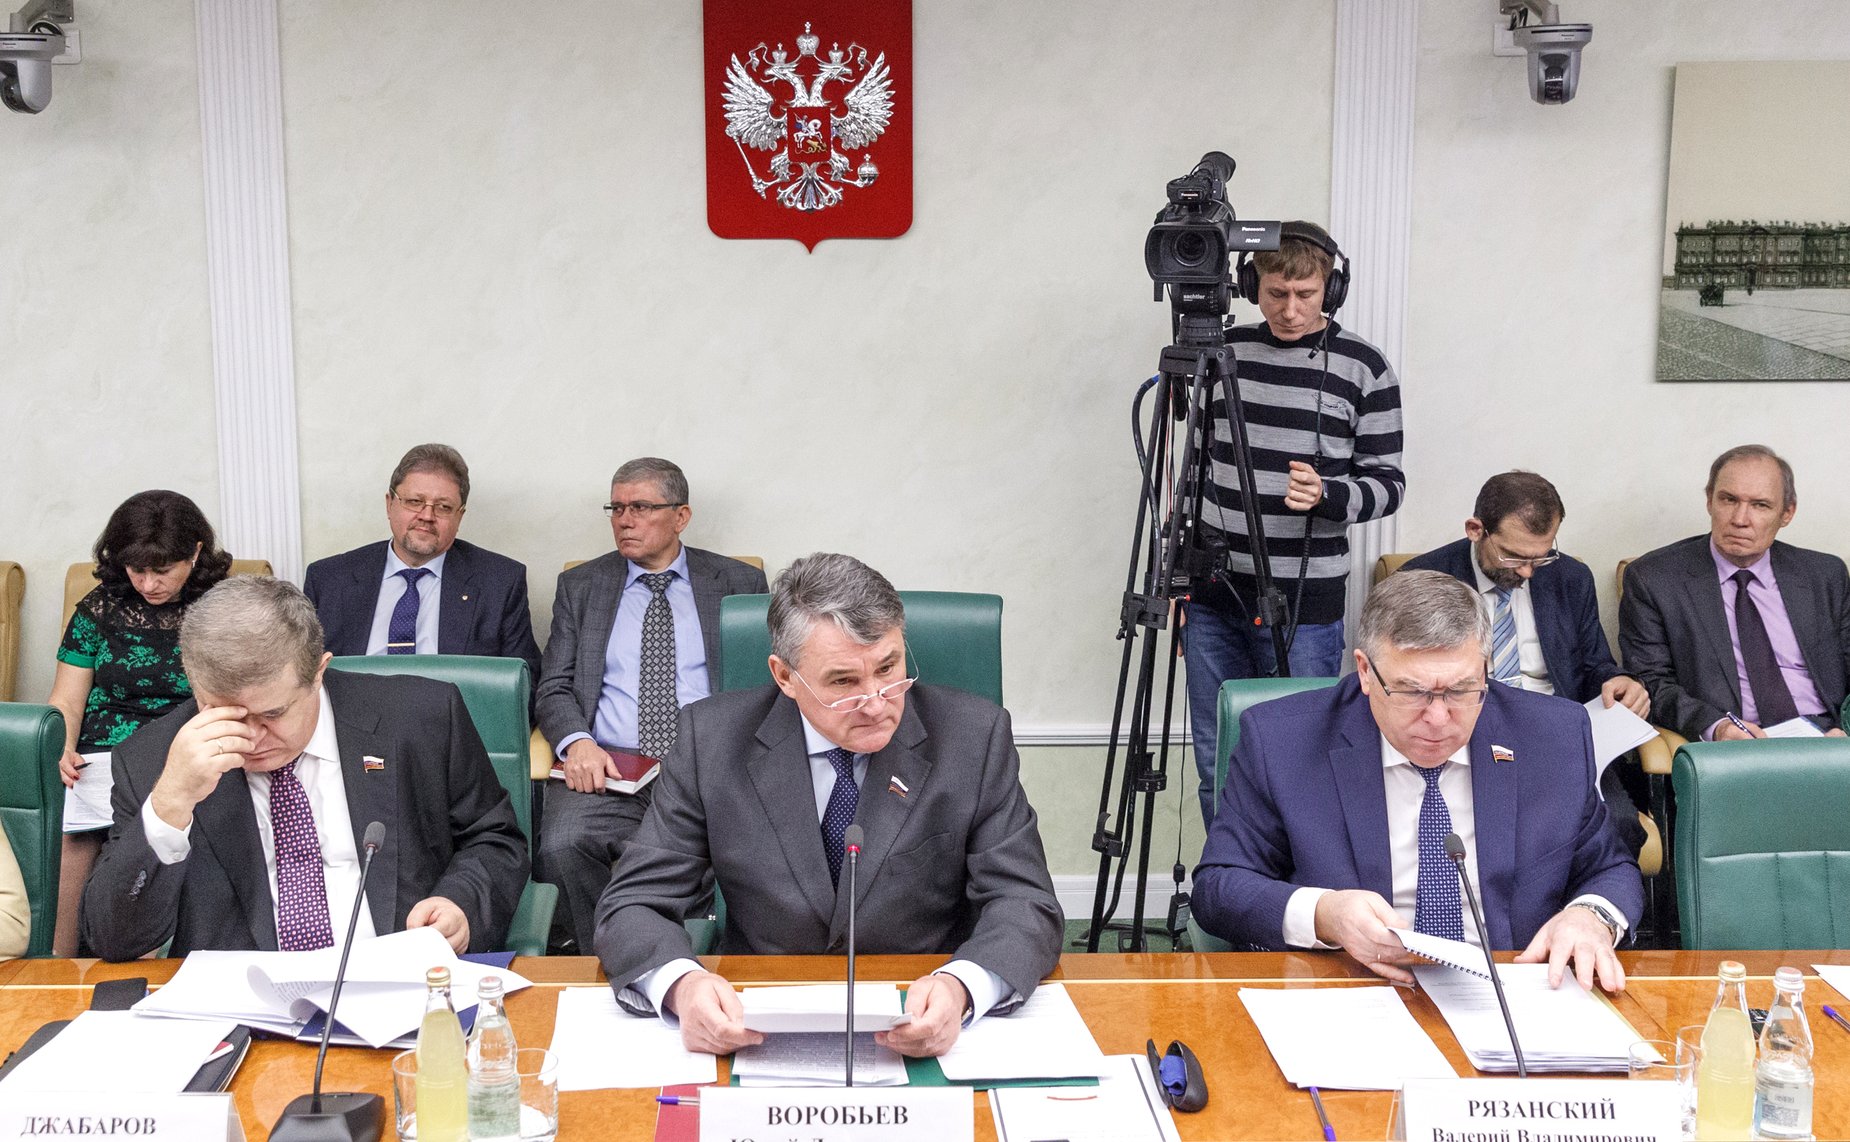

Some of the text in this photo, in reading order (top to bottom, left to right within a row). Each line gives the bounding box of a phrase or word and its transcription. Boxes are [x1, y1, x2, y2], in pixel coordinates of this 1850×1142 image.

[767, 1105, 909, 1126] ВОРОБЬЕВ
[1468, 1098, 1616, 1120] РЯЗАНСКИЙ
[20, 1116, 156, 1137] ДЖАБАРОВ
[1432, 1127, 1510, 1142] Валерий
